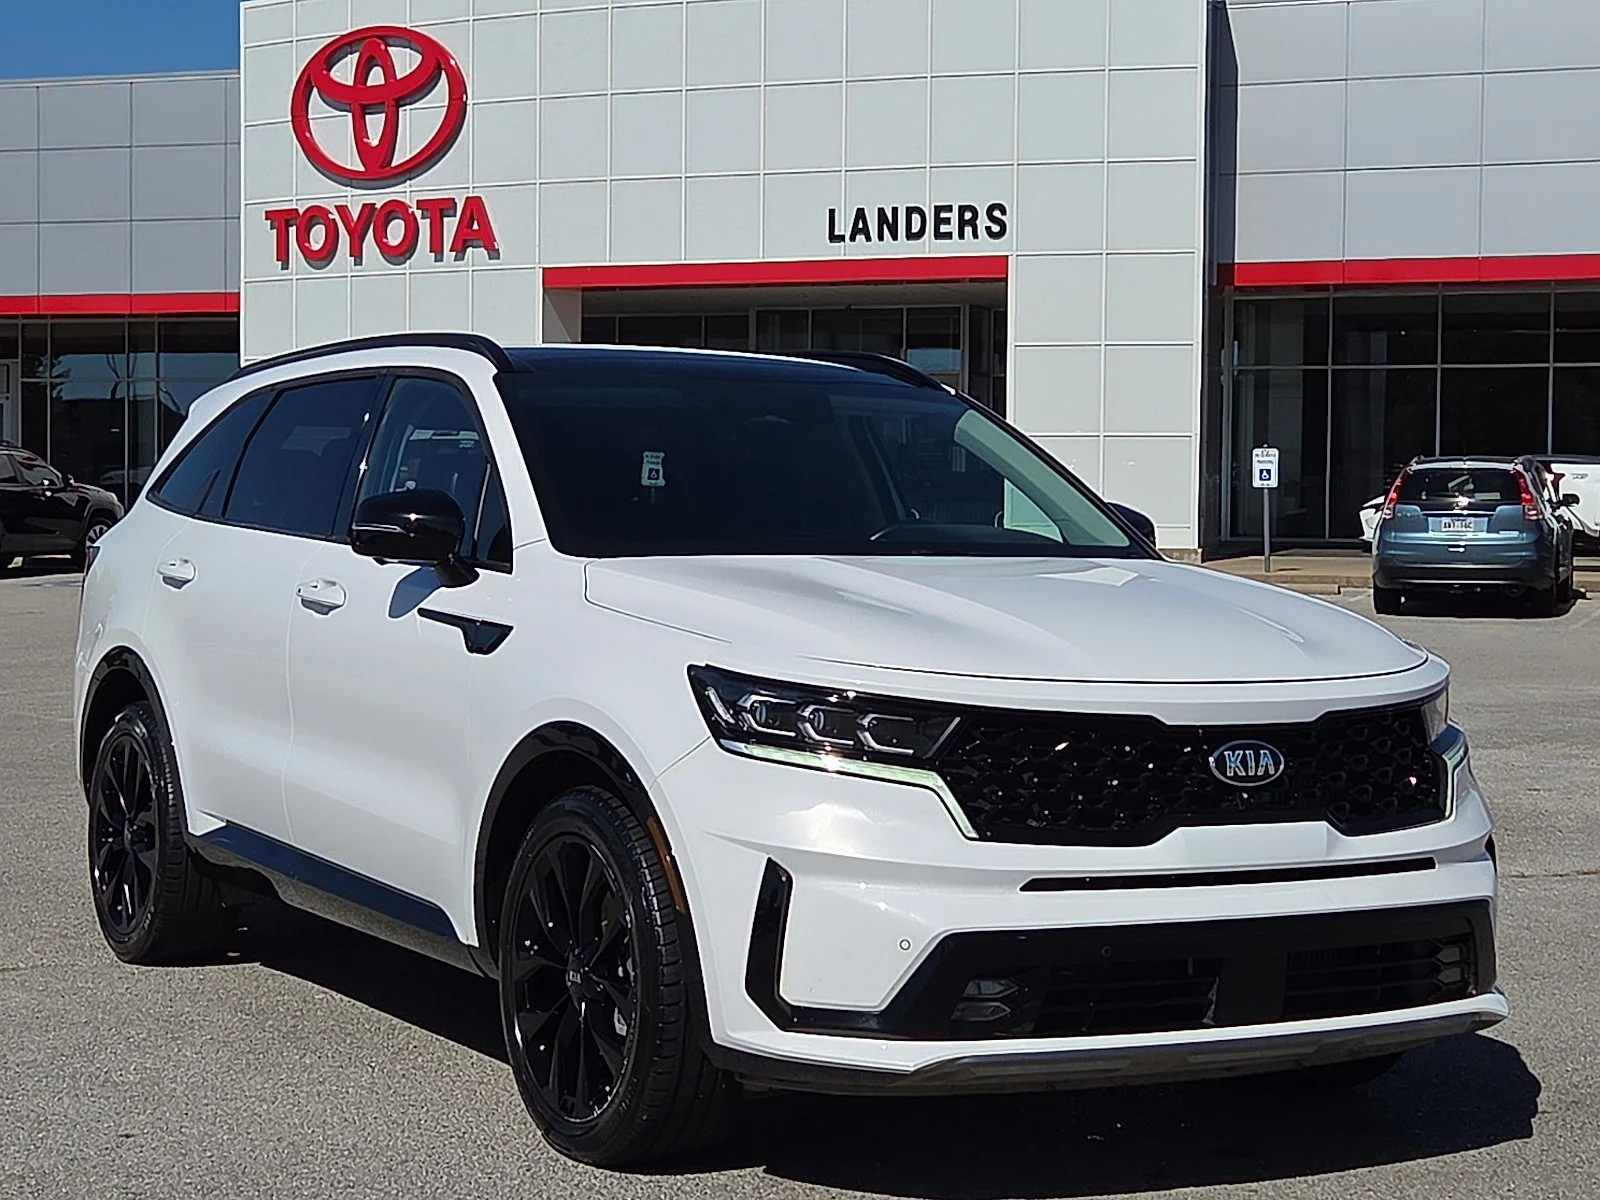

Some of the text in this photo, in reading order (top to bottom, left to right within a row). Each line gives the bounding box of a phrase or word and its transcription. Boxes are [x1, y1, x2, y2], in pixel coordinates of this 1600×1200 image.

[265, 195, 499, 267] TOYOTA
[828, 203, 1007, 243] LANDERS
[1224, 750, 1275, 776] KIA
